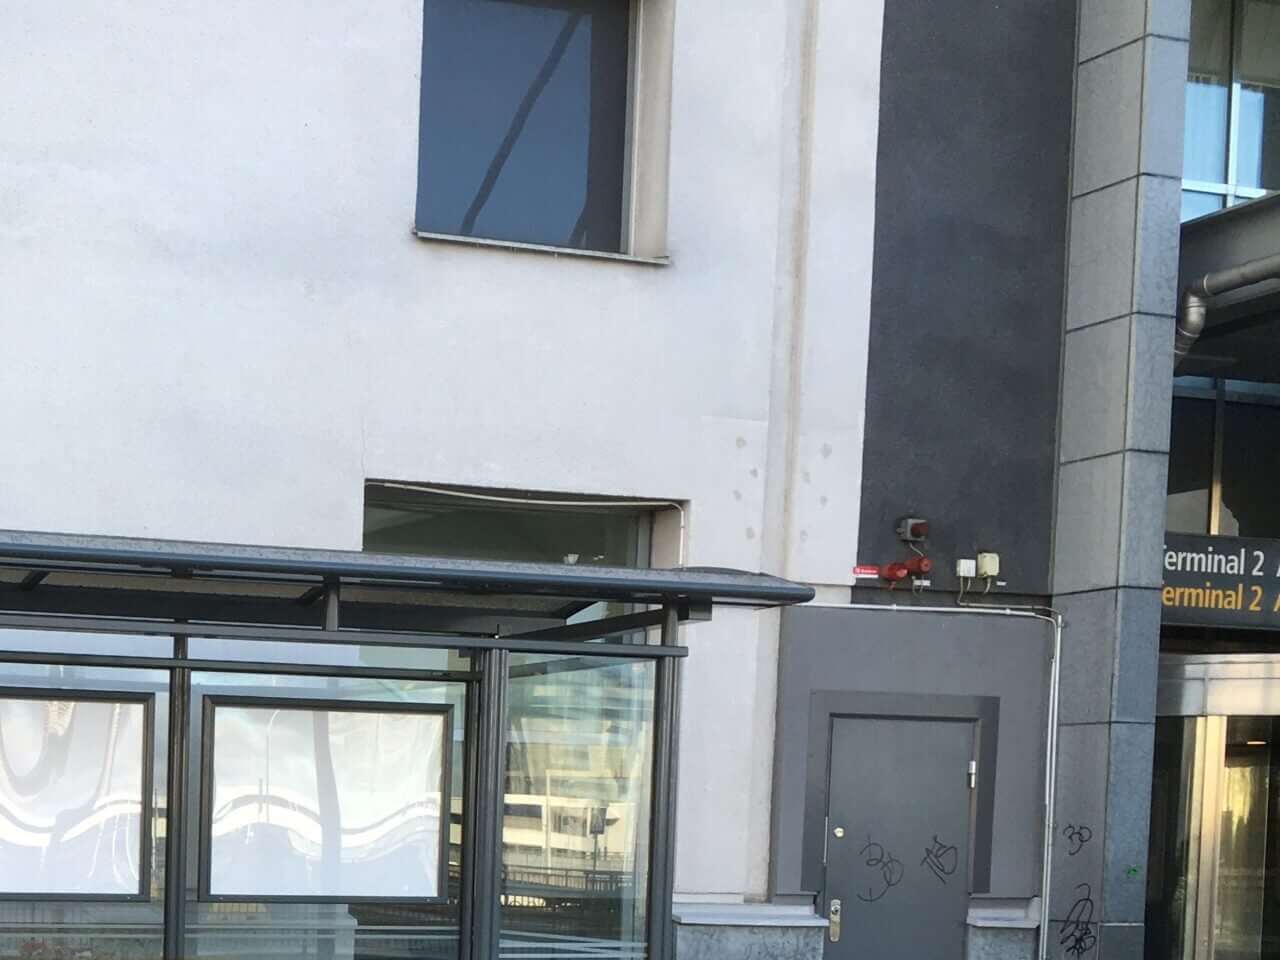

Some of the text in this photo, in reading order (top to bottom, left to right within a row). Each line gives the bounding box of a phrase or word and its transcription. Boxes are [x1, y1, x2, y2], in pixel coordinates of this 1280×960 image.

[1163, 545, 1246, 576] erminal
[1251, 550, 1265, 577] 2
[1161, 581, 1243, 611] erminal
[1248, 584, 1263, 612] 2
